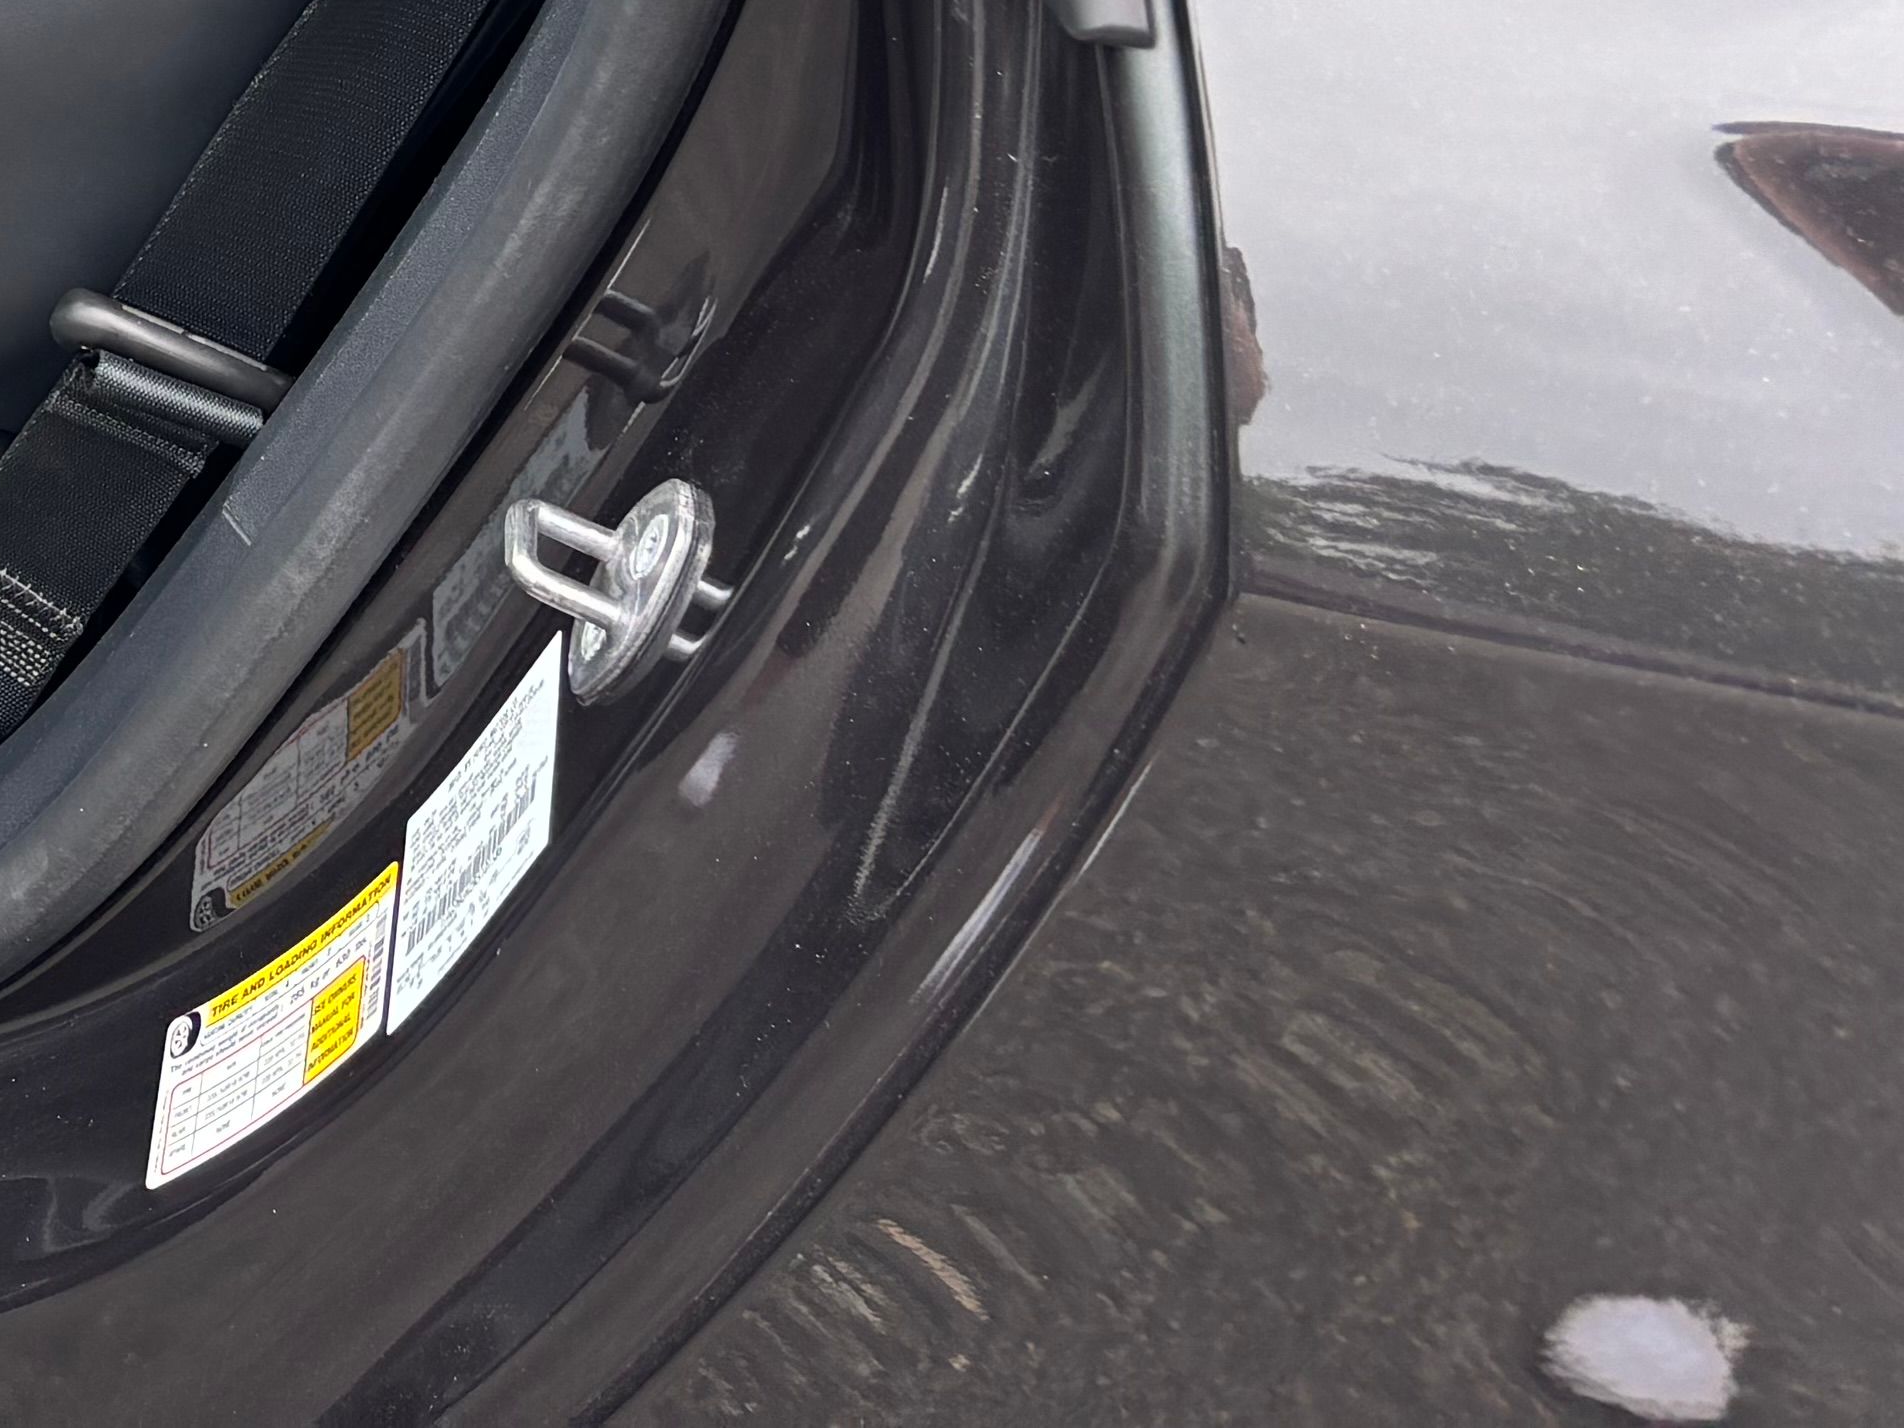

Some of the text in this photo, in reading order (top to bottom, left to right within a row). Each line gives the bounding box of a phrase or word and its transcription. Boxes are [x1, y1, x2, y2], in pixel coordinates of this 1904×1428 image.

[211, 990, 239, 1017] TIRE
[242, 977, 266, 1001] AND
[269, 940, 318, 981] LOADING
[320, 873, 392, 945] INFORMATION
